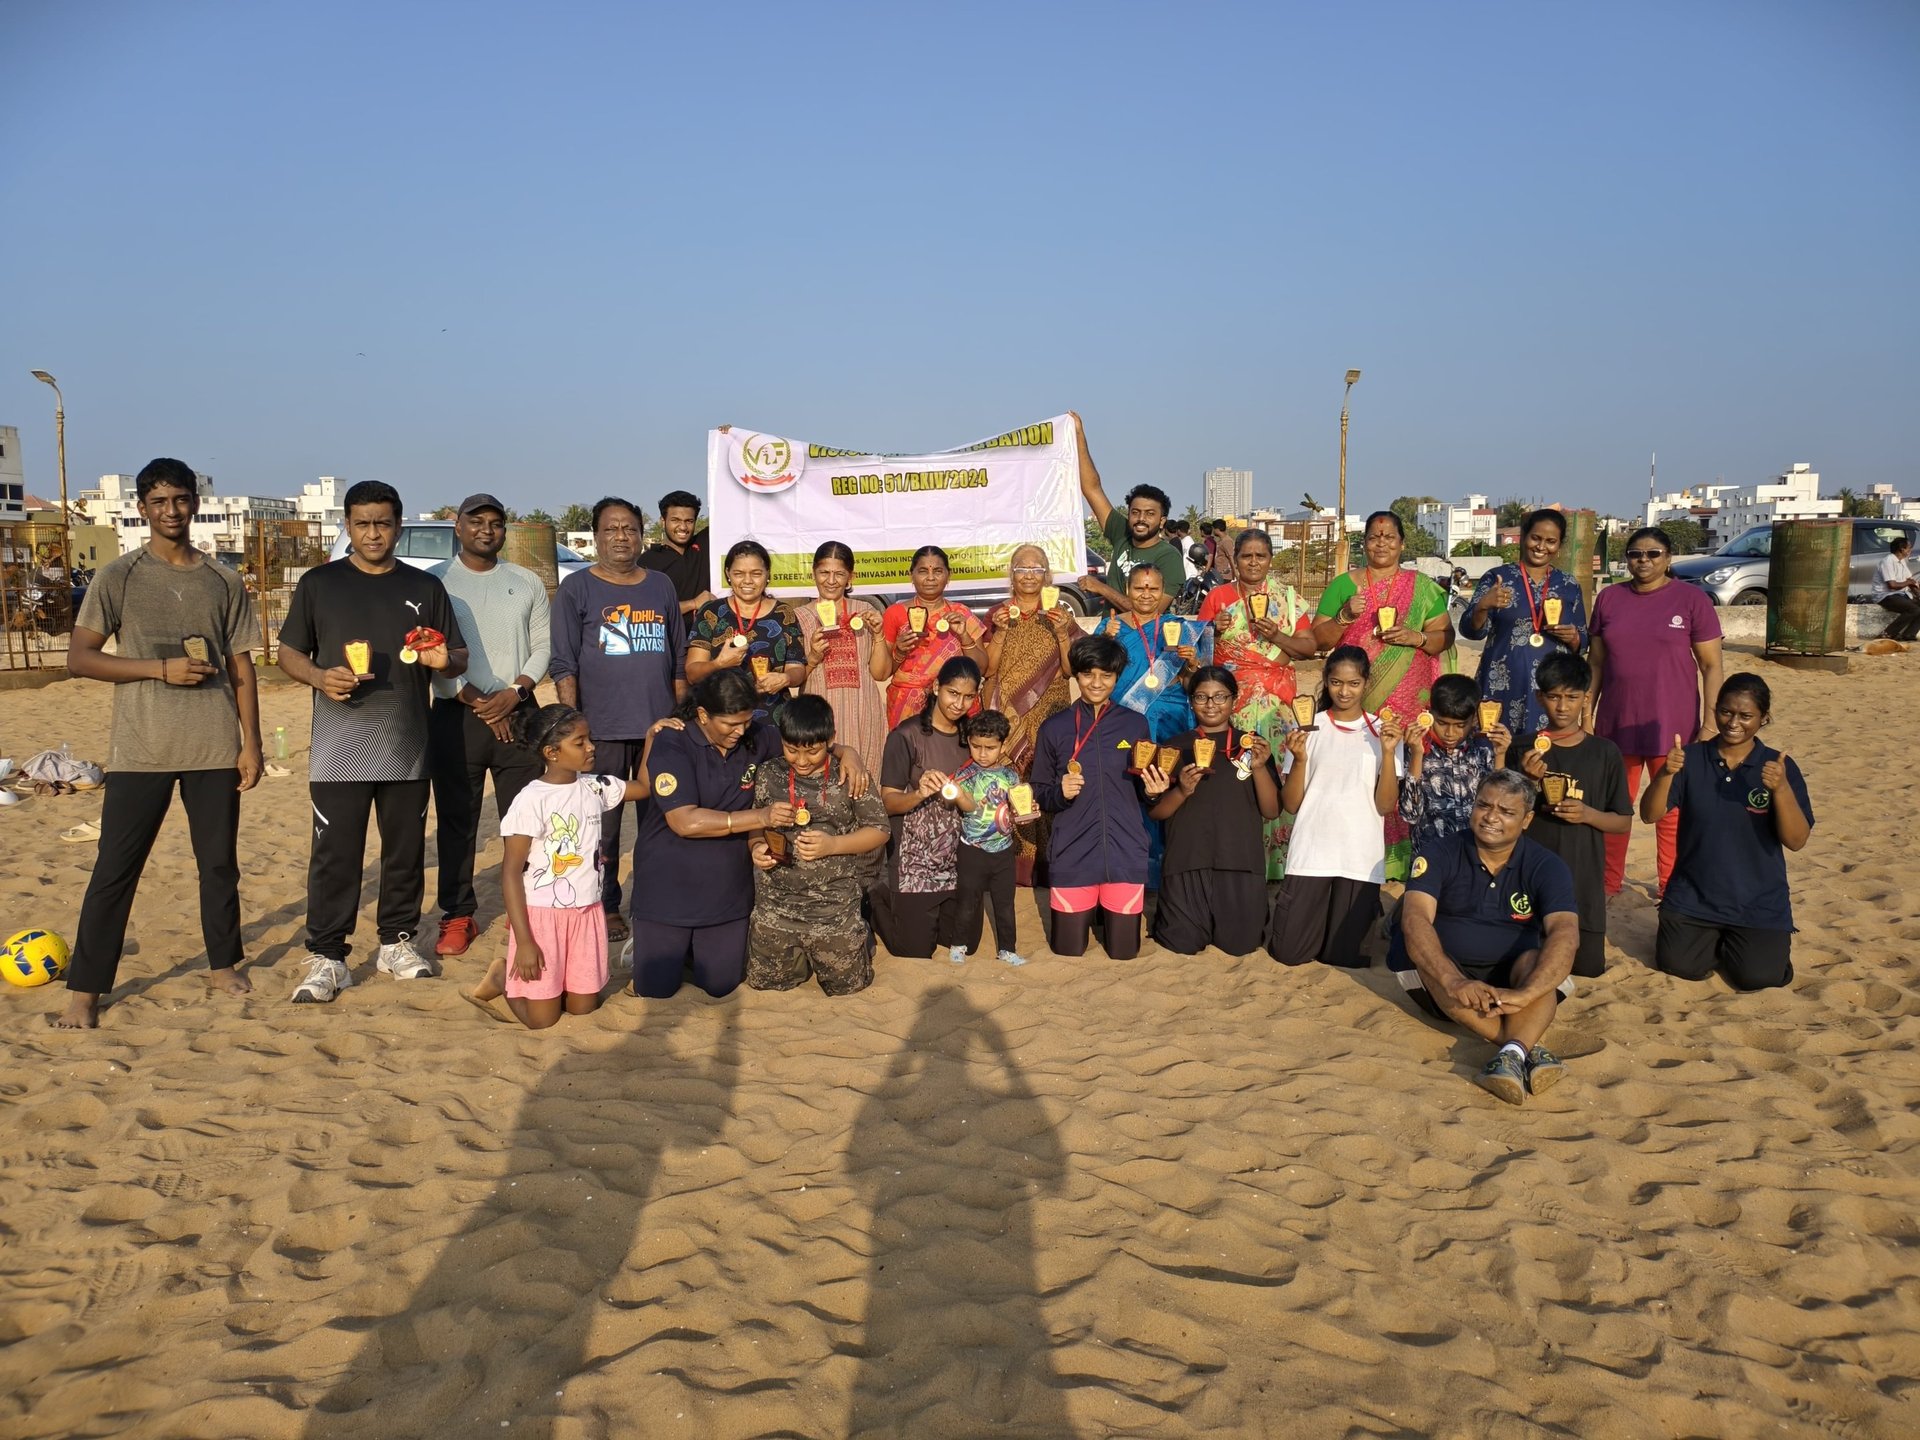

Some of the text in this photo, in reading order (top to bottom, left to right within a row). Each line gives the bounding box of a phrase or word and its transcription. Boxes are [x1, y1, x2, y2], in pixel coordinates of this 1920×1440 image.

[831, 477, 858, 495] REG
[859, 474, 883, 494] NO:
[872, 556, 898, 564] VISION
[855, 570, 896, 578] RINIVASAN
[632, 610, 655, 623] IDHU
